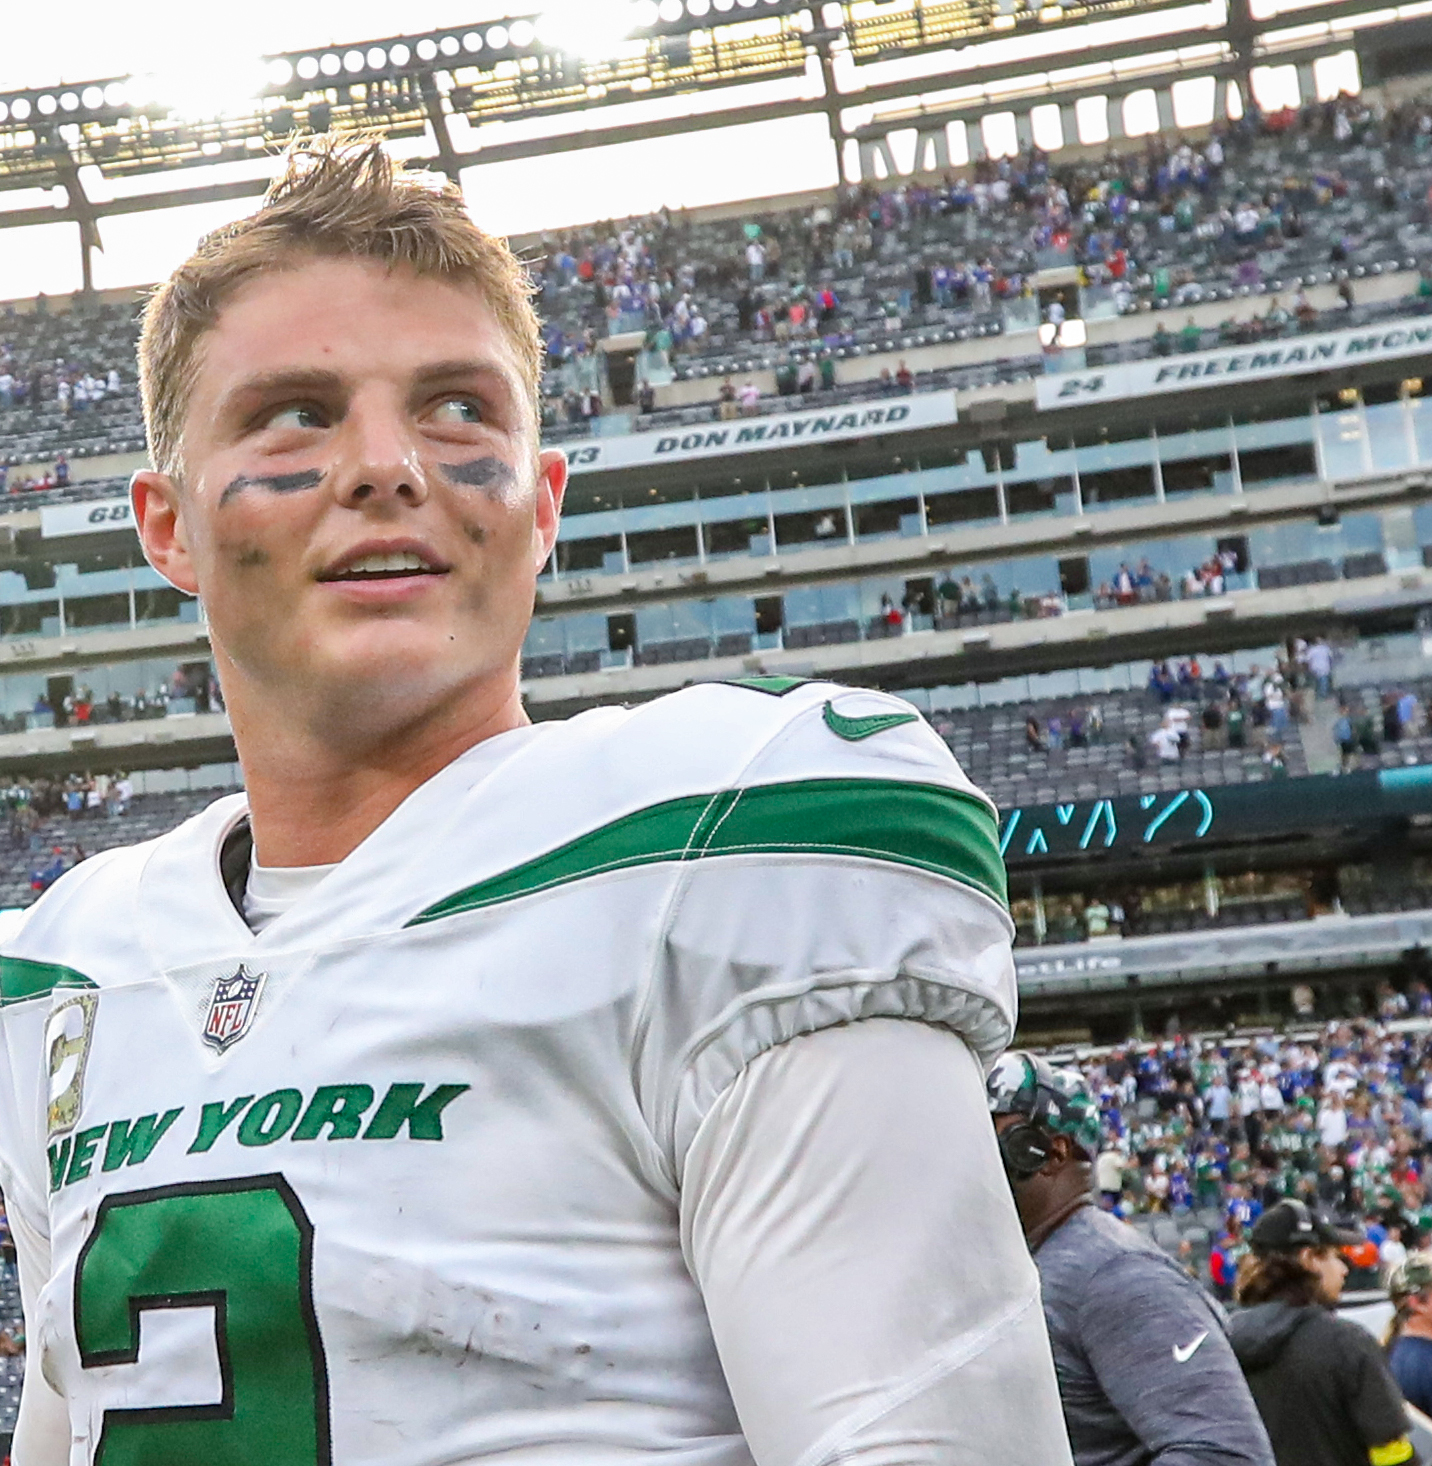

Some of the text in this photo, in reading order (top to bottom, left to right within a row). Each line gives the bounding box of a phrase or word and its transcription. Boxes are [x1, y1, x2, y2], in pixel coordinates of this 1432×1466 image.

[1057, 375, 1105, 398] 24
[1154, 341, 1338, 384] FREEMAN
[654, 428, 728, 455] DON
[734, 403, 911, 444] MAYNARD
[208, 1002, 244, 1037] NFL
[186, 1082, 472, 1156] YORK
